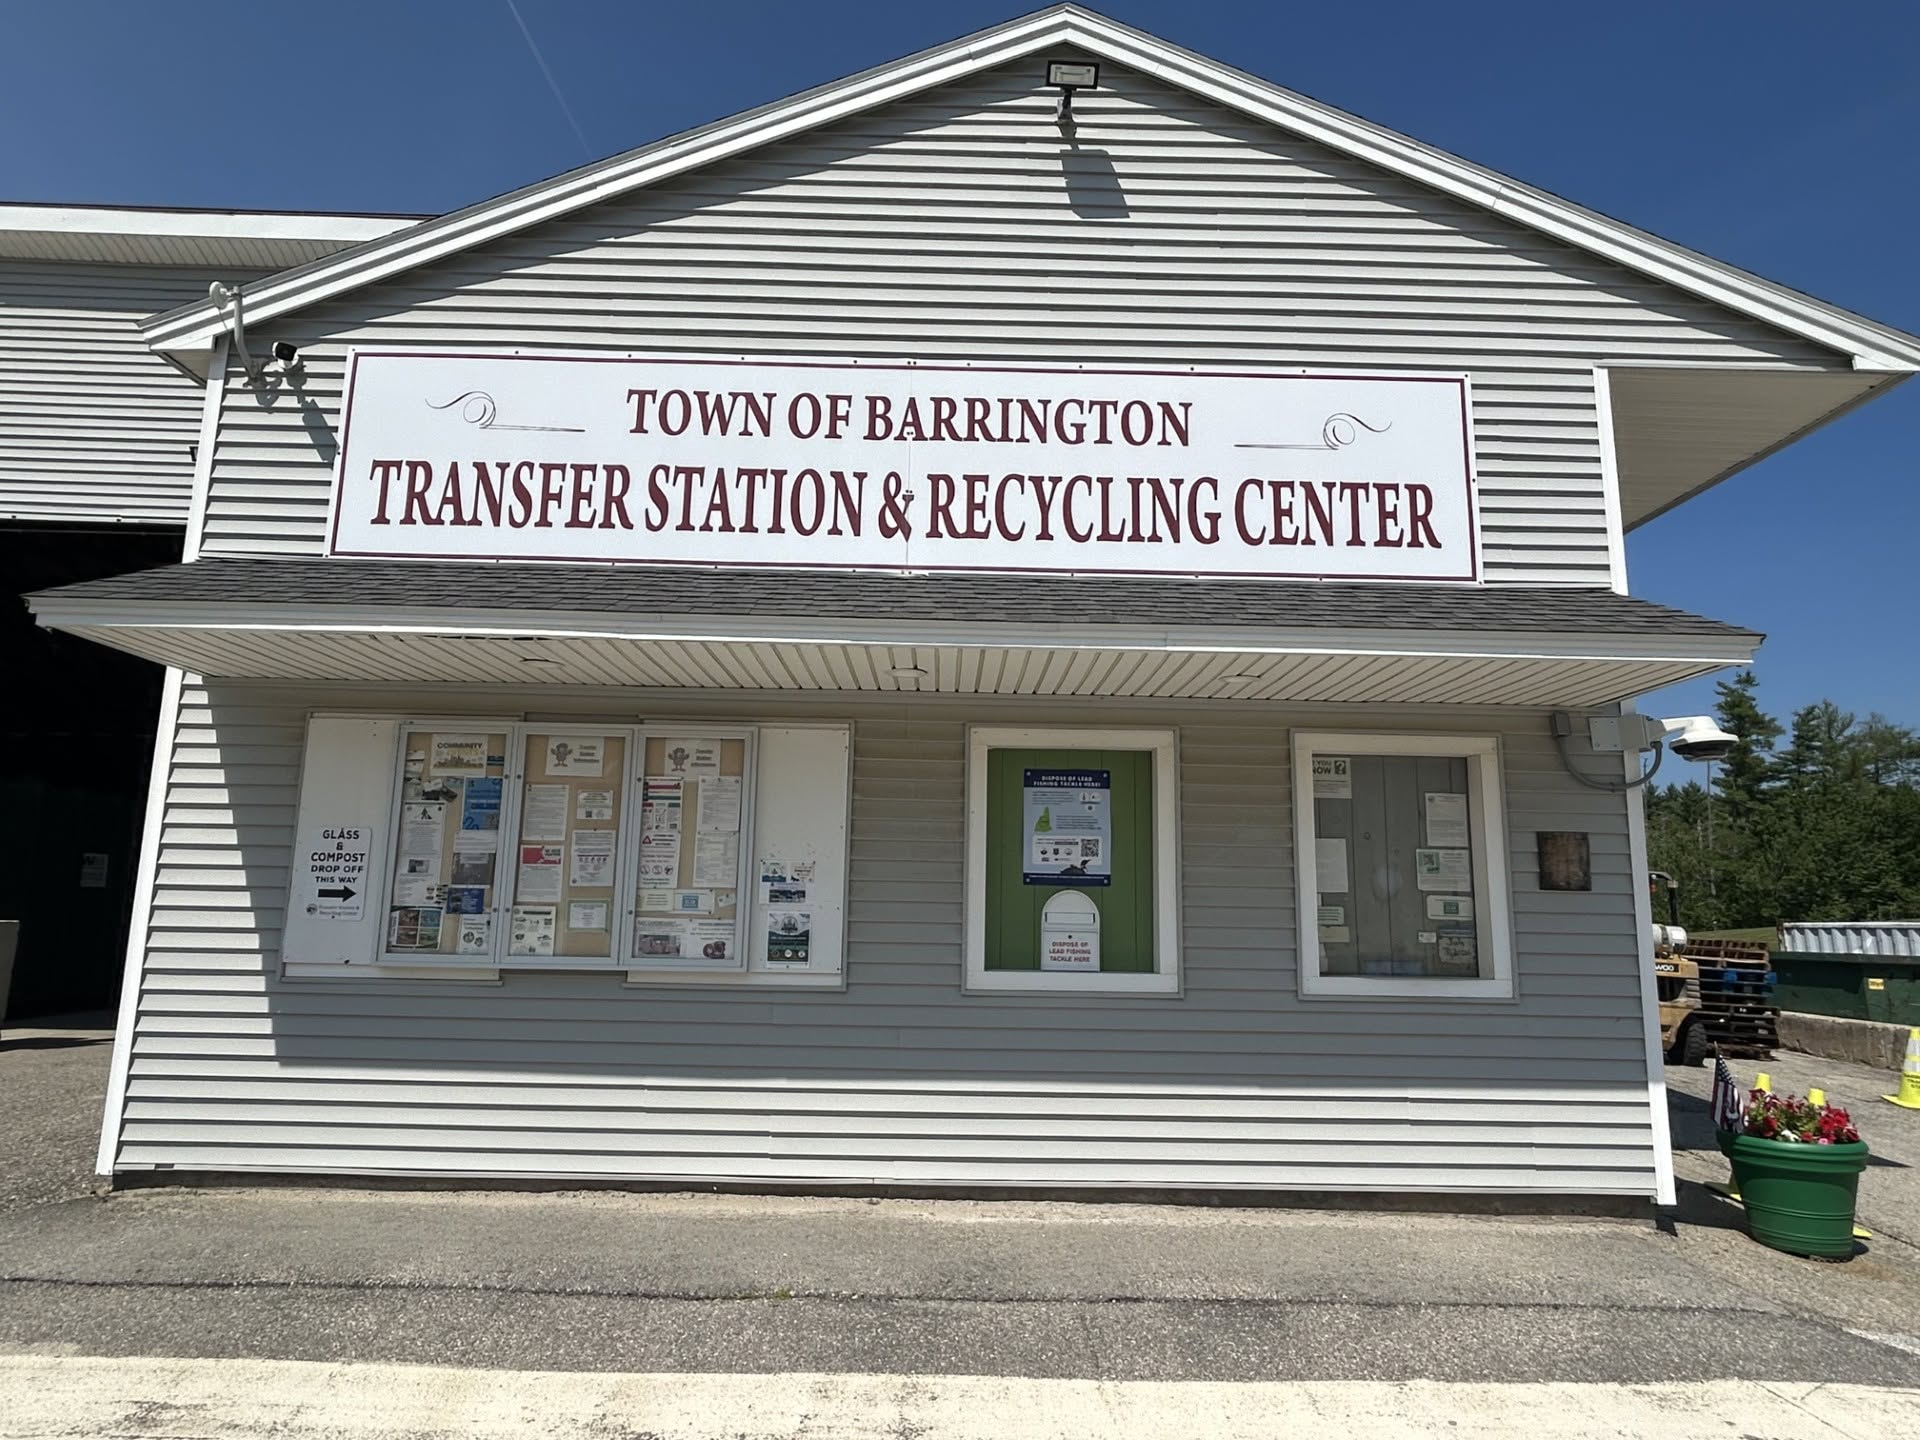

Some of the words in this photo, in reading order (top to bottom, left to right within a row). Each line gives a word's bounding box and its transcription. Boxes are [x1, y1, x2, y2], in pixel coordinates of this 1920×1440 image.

[627, 389, 777, 437] TOWN
[787, 393, 852, 440] OF
[864, 396, 1192, 446] BARRINGTON
[370, 460, 634, 530] TRANSFER
[645, 464, 867, 537] STATION
[878, 471, 914, 542] &
[926, 473, 1222, 545] RECYCLING
[1234, 478, 1442, 549] CENTER
[322, 829, 360, 840] GLASS
[336, 842, 344, 851] &
[311, 852, 365, 862] COMPOST
[311, 865, 340, 873] DROP
[343, 865, 365, 873] OFF
